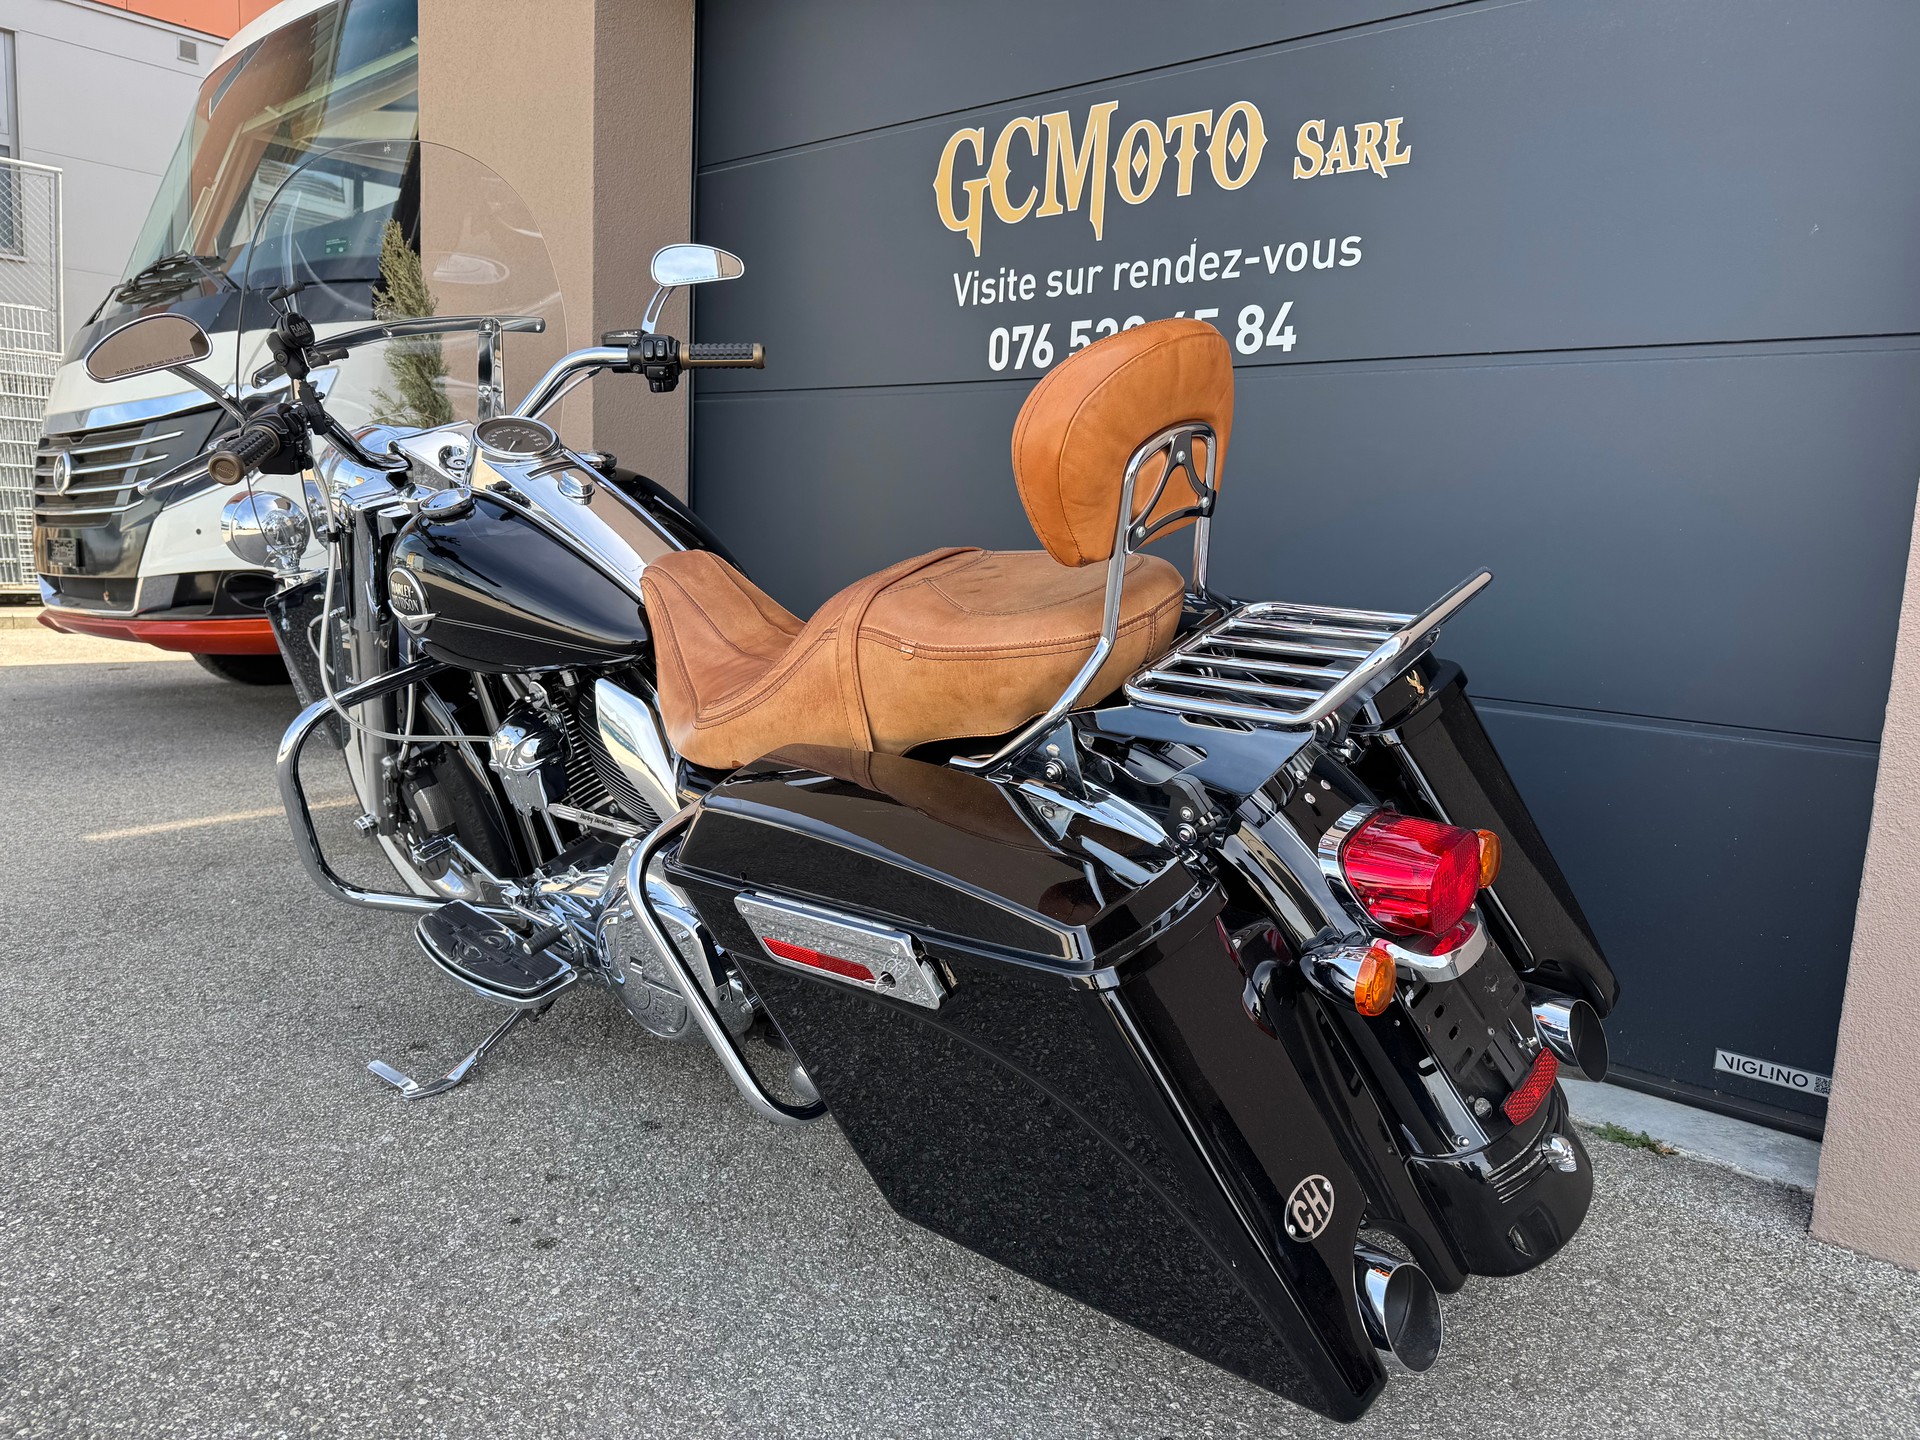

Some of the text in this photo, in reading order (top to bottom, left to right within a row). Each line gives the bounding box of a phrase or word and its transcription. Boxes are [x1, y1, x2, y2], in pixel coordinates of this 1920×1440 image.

[1293, 116, 1411, 180] SARL
[953, 235, 1363, 307] Visite sur rendez-vous
[988, 323, 1054, 371] 076
[1235, 301, 1298, 355] 84
[1293, 1180, 1330, 1233] CH
